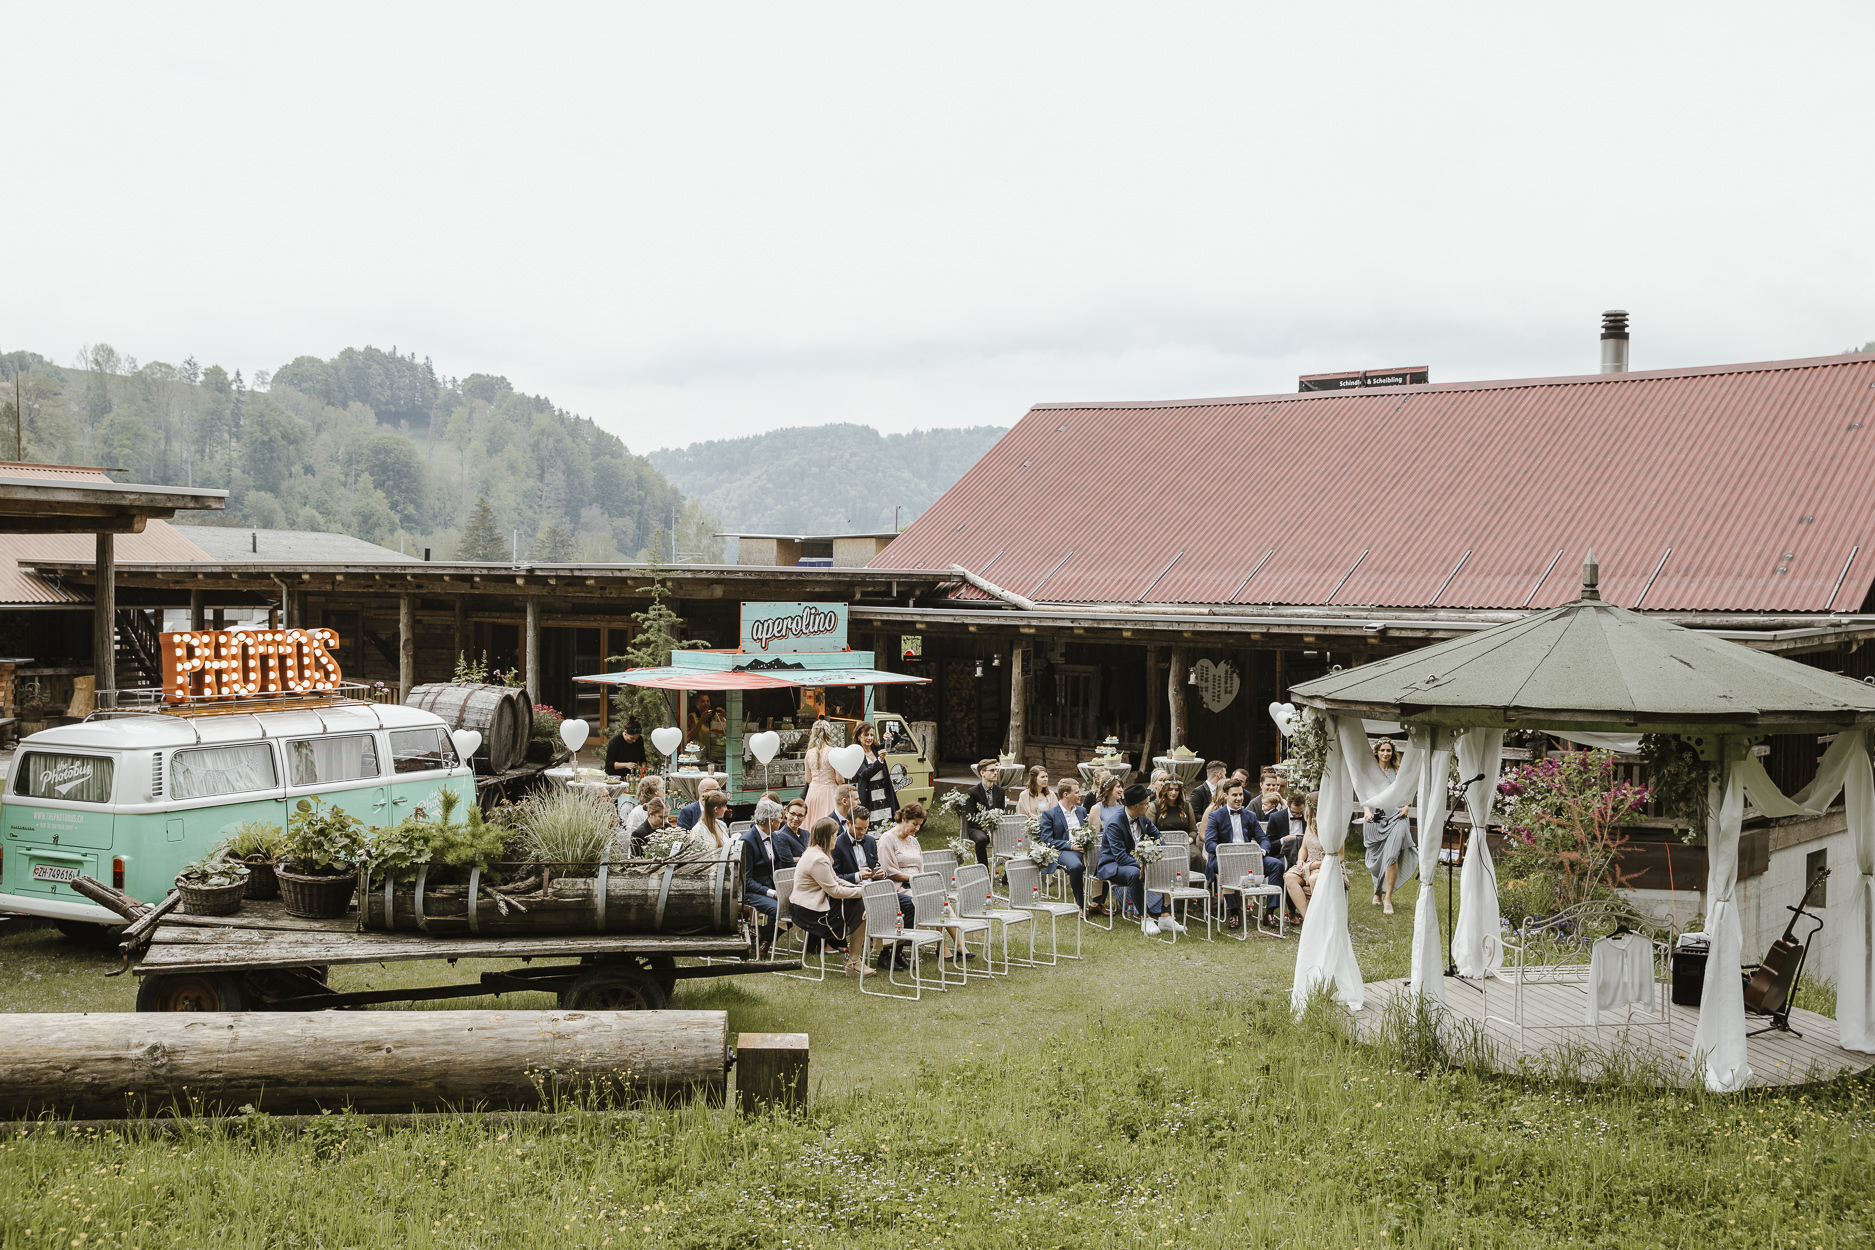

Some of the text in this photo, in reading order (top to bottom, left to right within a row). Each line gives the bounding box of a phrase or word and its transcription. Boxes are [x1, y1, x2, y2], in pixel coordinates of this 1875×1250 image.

[1373, 377, 1403, 385] Scheibling
[752, 606, 838, 650] aperolino
[160, 628, 341, 702] PHOTOS
[40, 761, 92, 793] Photobus
[57, 760, 68, 771] the
